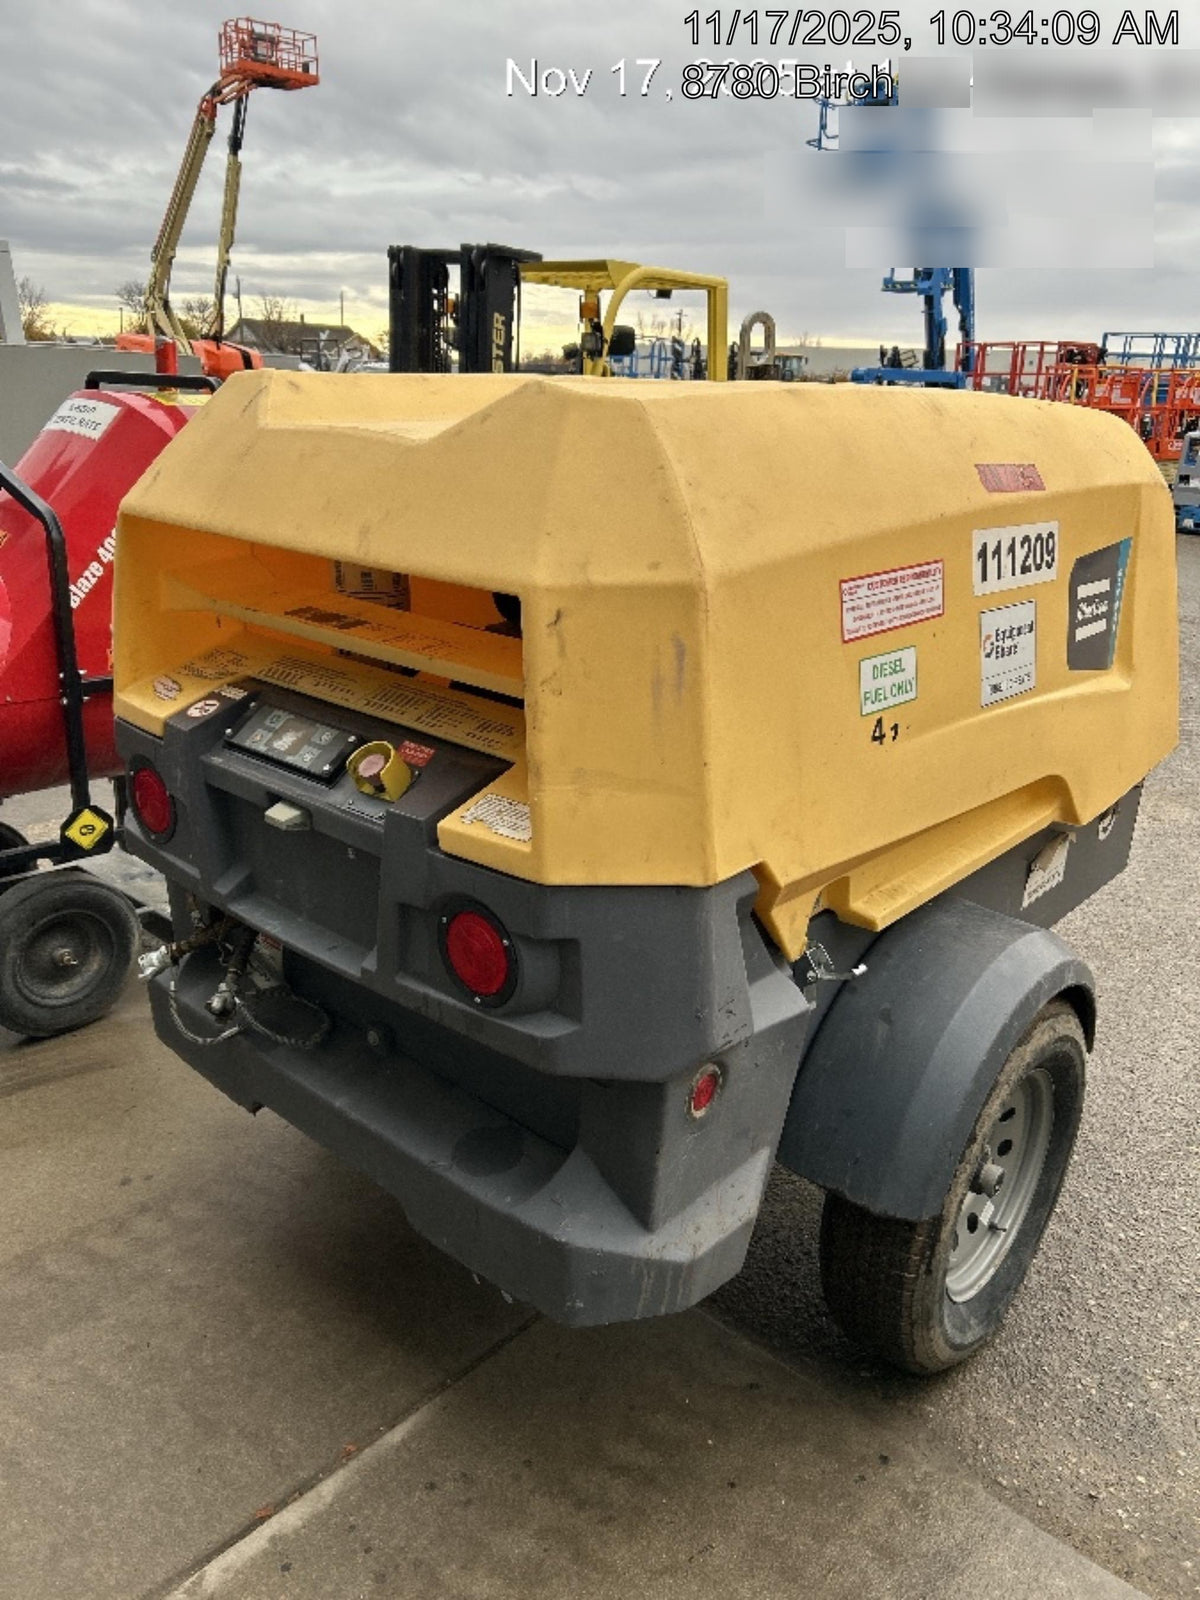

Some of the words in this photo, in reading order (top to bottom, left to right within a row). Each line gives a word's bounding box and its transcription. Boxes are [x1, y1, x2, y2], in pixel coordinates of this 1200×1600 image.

[976, 530, 1056, 583] 111209
[872, 657, 905, 680] DIESEL
[863, 687, 888, 706] FUEL
